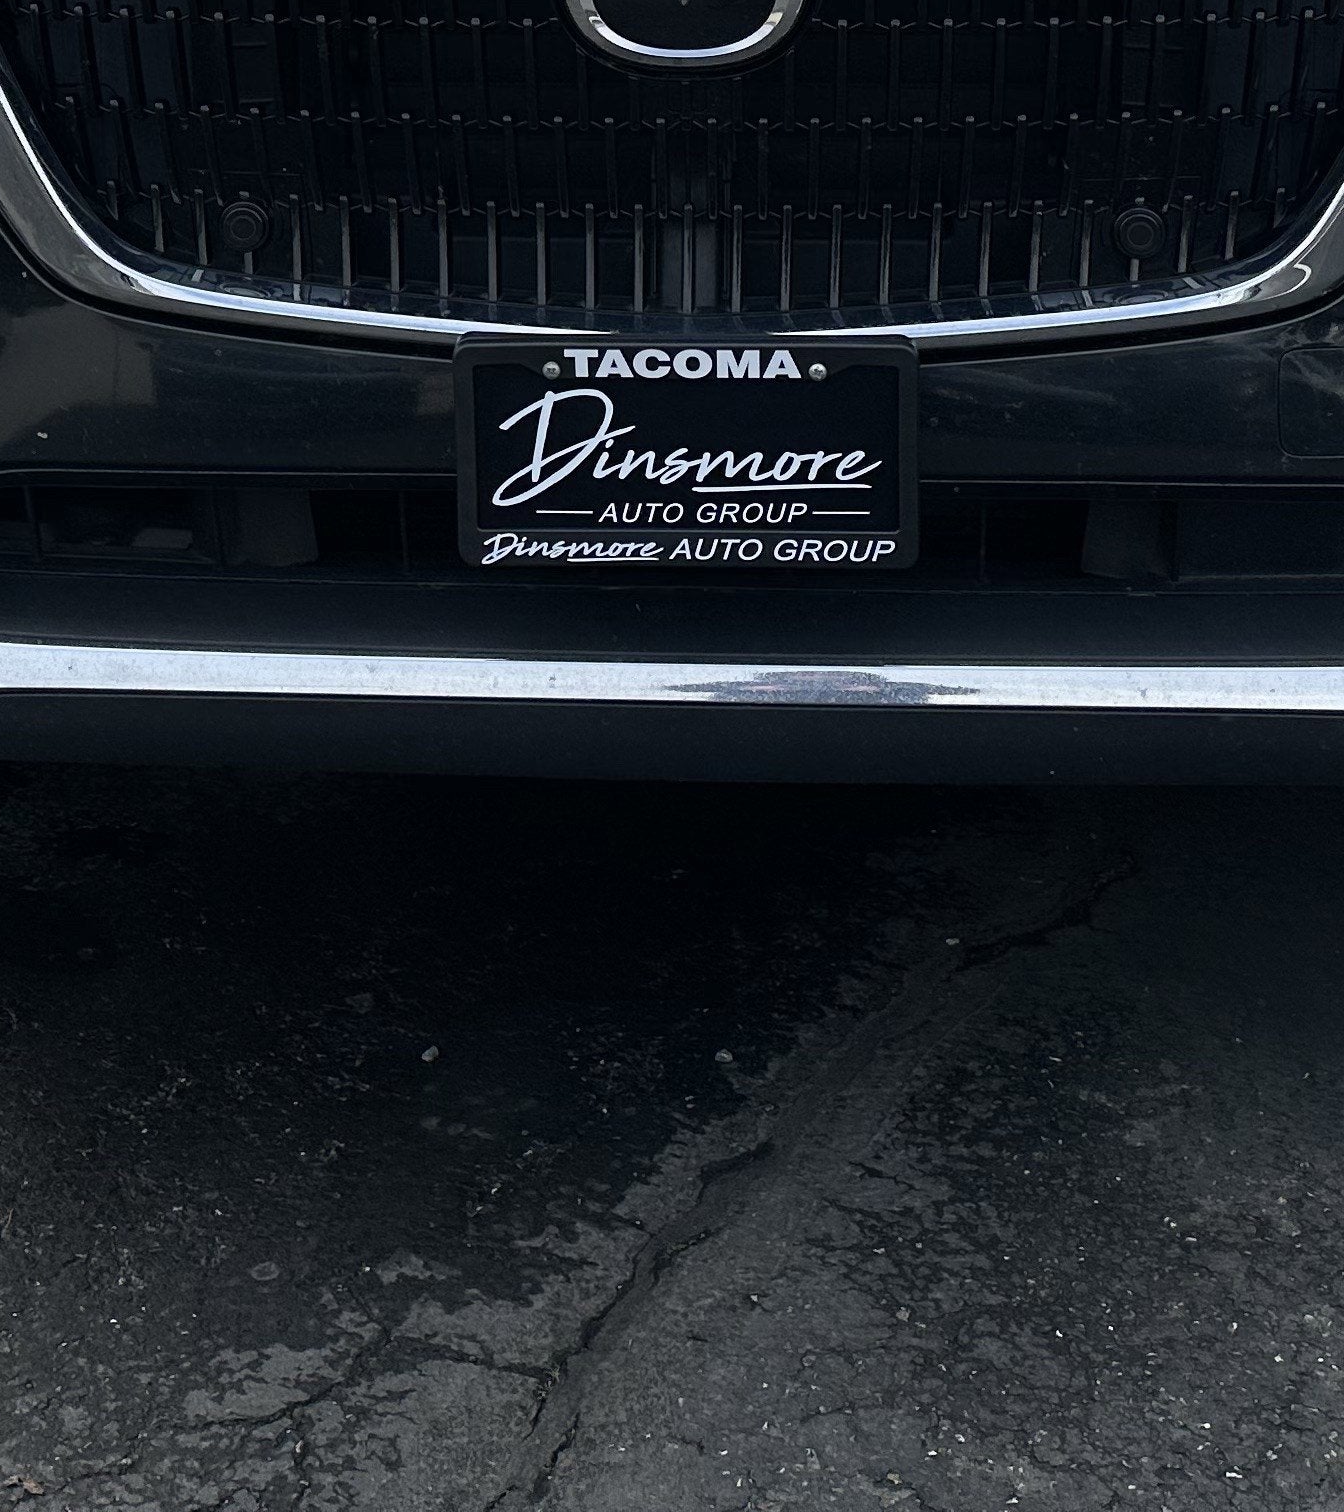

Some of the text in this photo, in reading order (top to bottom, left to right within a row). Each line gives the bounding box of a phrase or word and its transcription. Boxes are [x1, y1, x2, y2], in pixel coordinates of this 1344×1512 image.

[564, 349, 802, 380] TACOMA
[491, 387, 883, 507] Dinsmore
[598, 502, 809, 524] AUTO GROUP
[480, 532, 897, 565] Dinsmore AUTO GROUP
